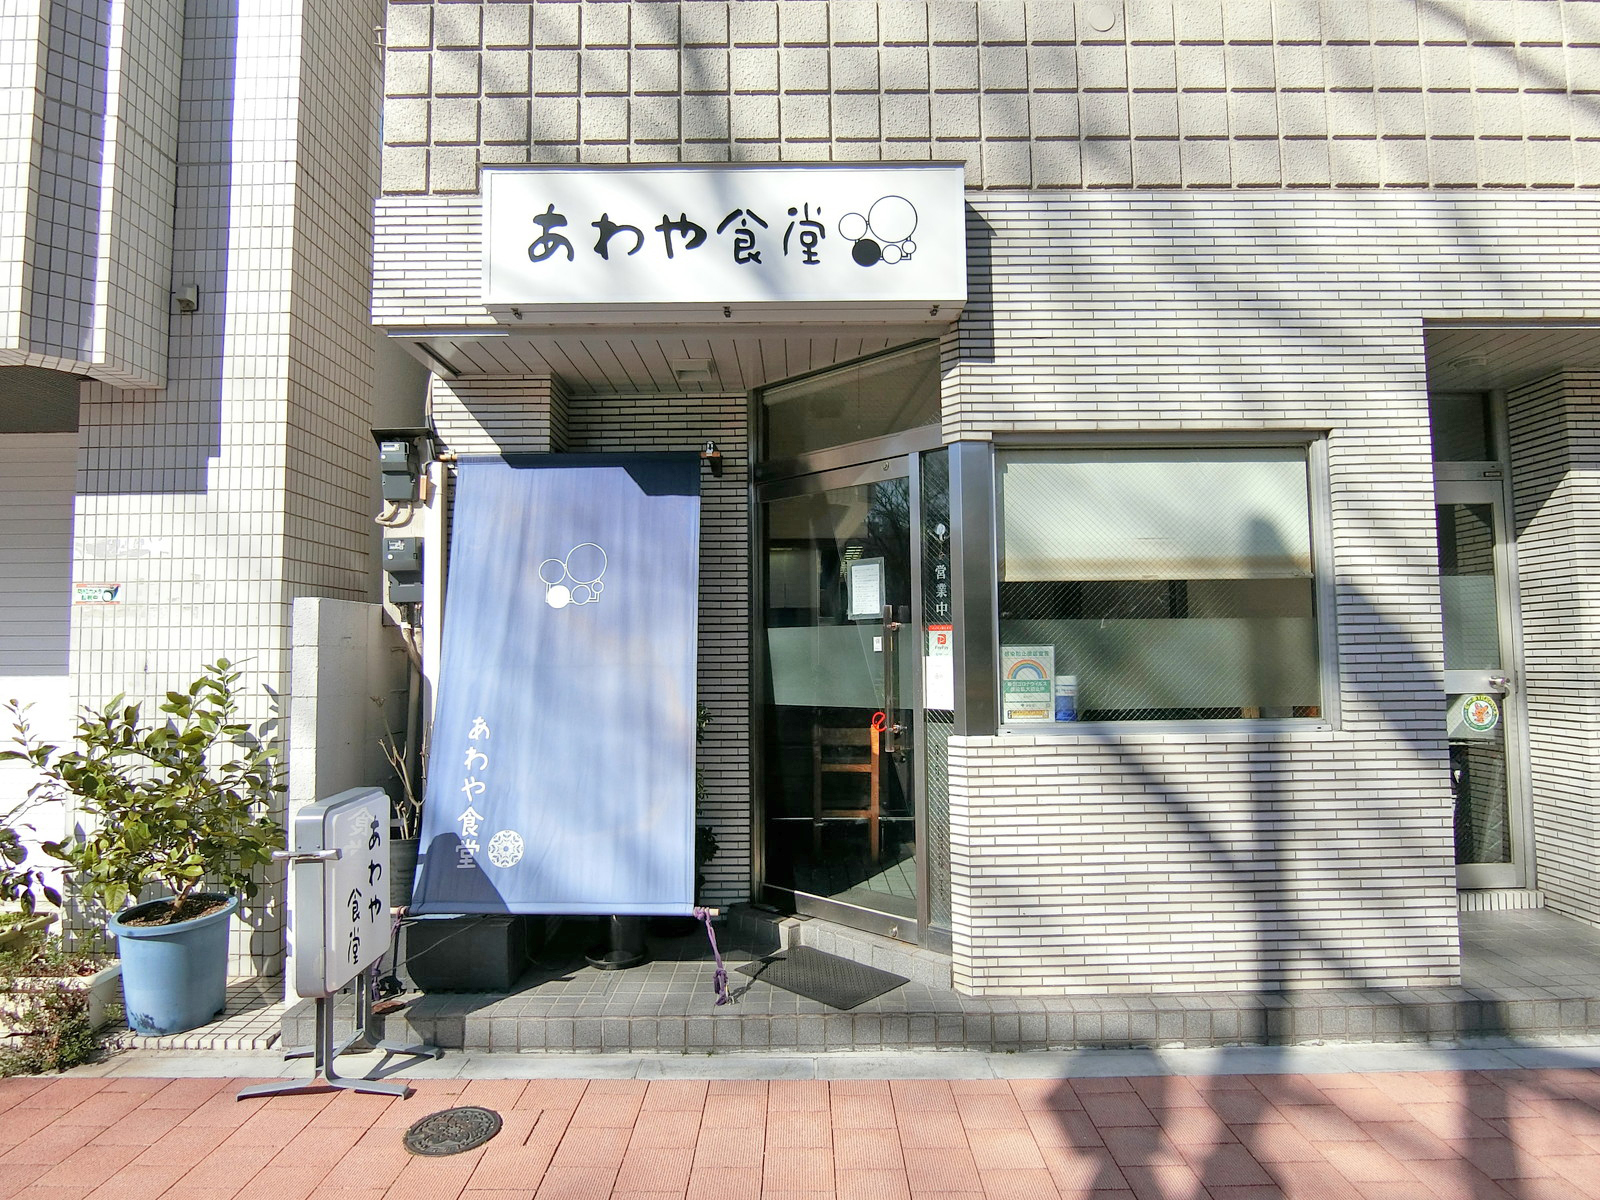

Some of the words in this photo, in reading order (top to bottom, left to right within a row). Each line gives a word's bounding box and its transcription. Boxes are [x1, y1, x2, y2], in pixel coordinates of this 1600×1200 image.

[527, 201, 826, 265] あわや食堂
[935, 564, 948, 616] 営業中
[455, 716, 491, 869] あわや食堂
[367, 815, 382, 923] あわや
[347, 888, 362, 964] 食堂
